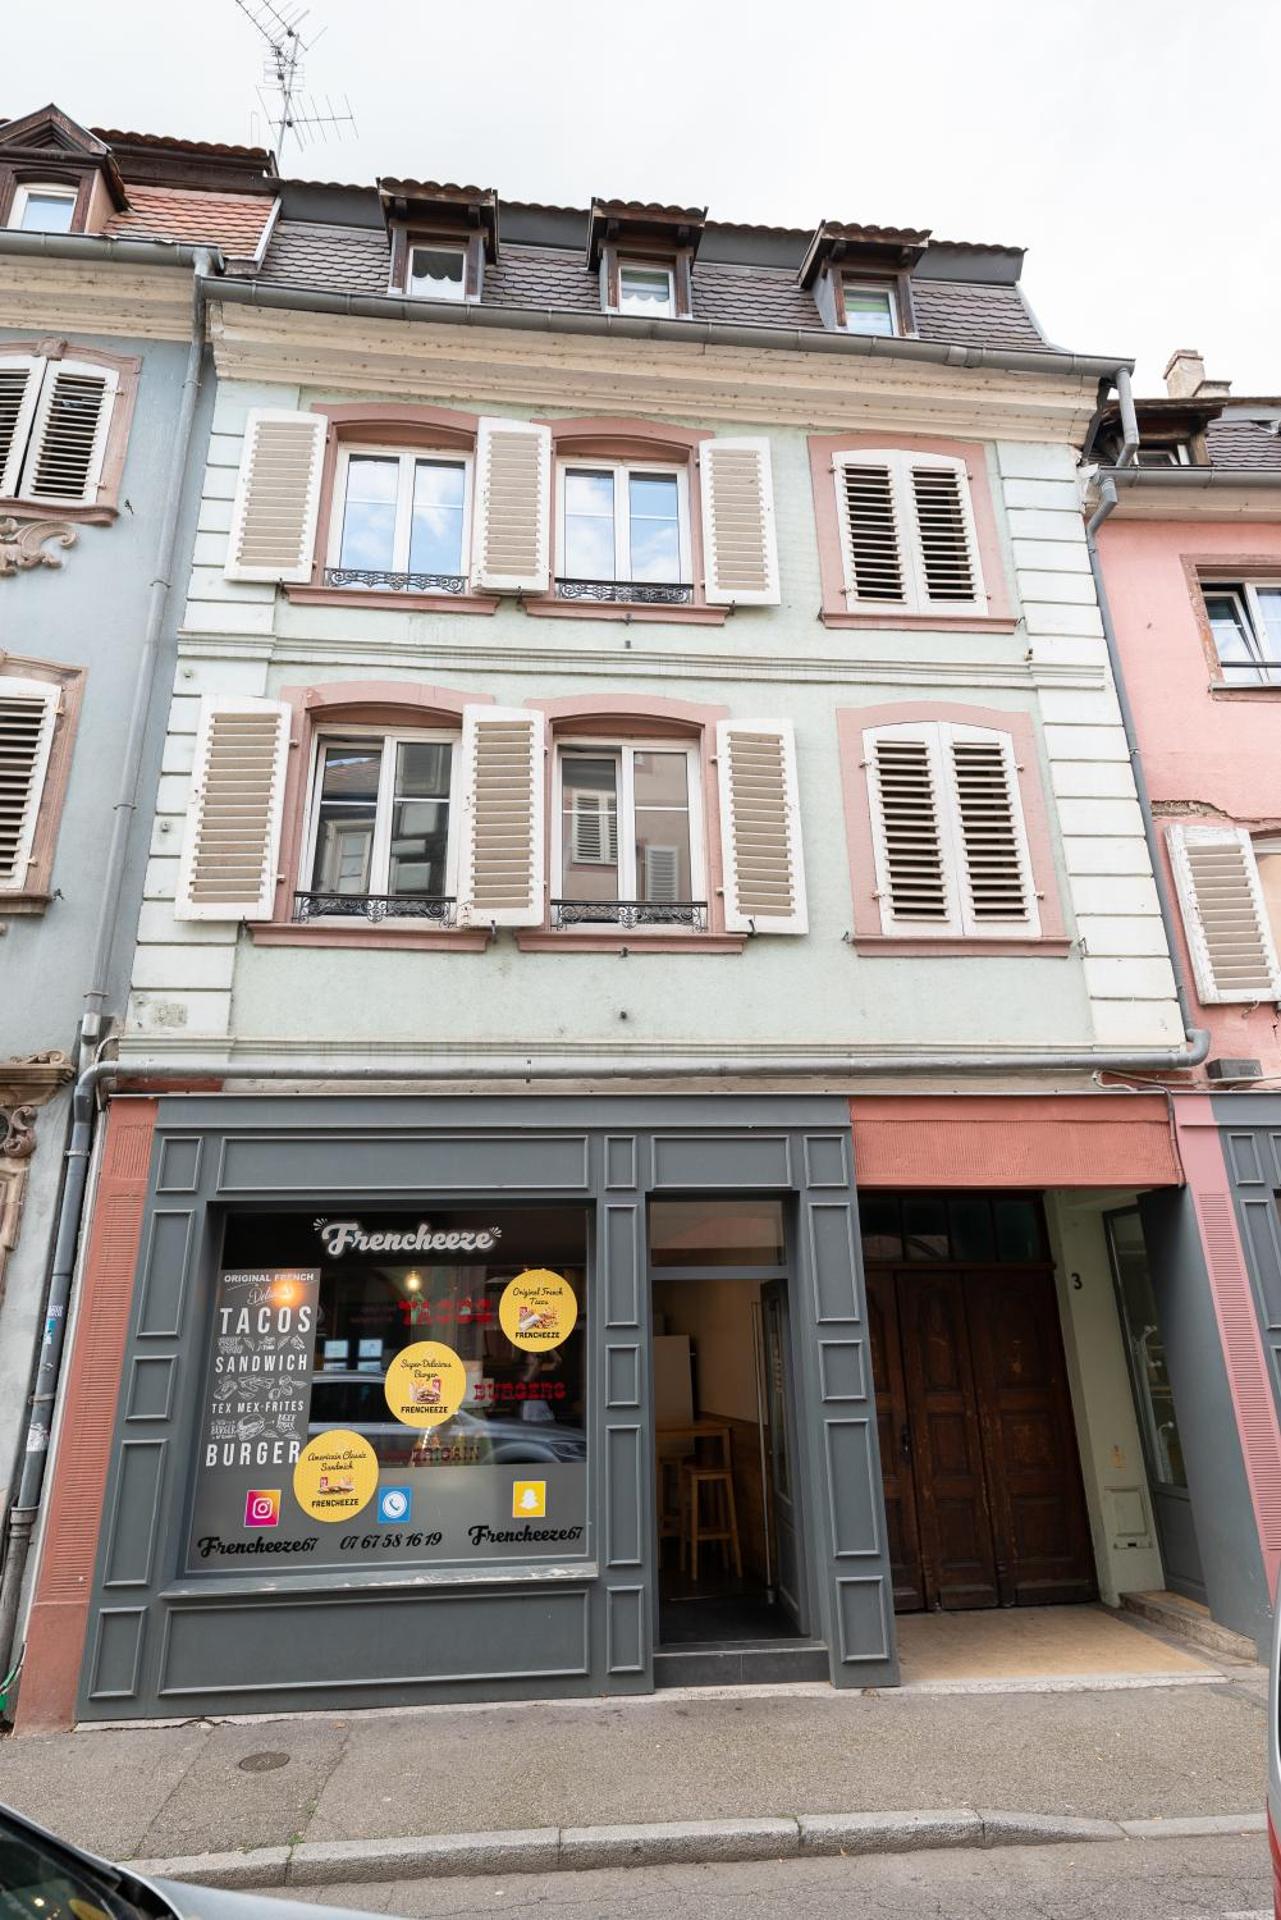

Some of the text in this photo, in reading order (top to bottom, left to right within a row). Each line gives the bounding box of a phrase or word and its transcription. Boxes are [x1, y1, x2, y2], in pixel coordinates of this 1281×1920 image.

[321, 1222, 495, 1256] Frencheeze
[224, 1273, 314, 1283] ORIGINAL FRENCH
[1071, 1272, 1083, 1290] 3
[512, 1287, 564, 1299] Original French
[220, 1305, 312, 1335] TACOS
[515, 1331, 560, 1339] FRENCHEEZE
[214, 1353, 308, 1373] SANDWICH
[414, 1368, 439, 1381] Burger
[211, 1402, 232, 1414] TEX
[400, 1406, 448, 1414] FRENCHEEZE
[205, 1440, 301, 1468] BURGER
[311, 1499, 359, 1508] FRENCHEEZE
[340, 1531, 443, 1550] 07 67 58 16 19
[467, 1525, 584, 1546] Frencheeze67
[197, 1536, 320, 1558] Frencheeze67
